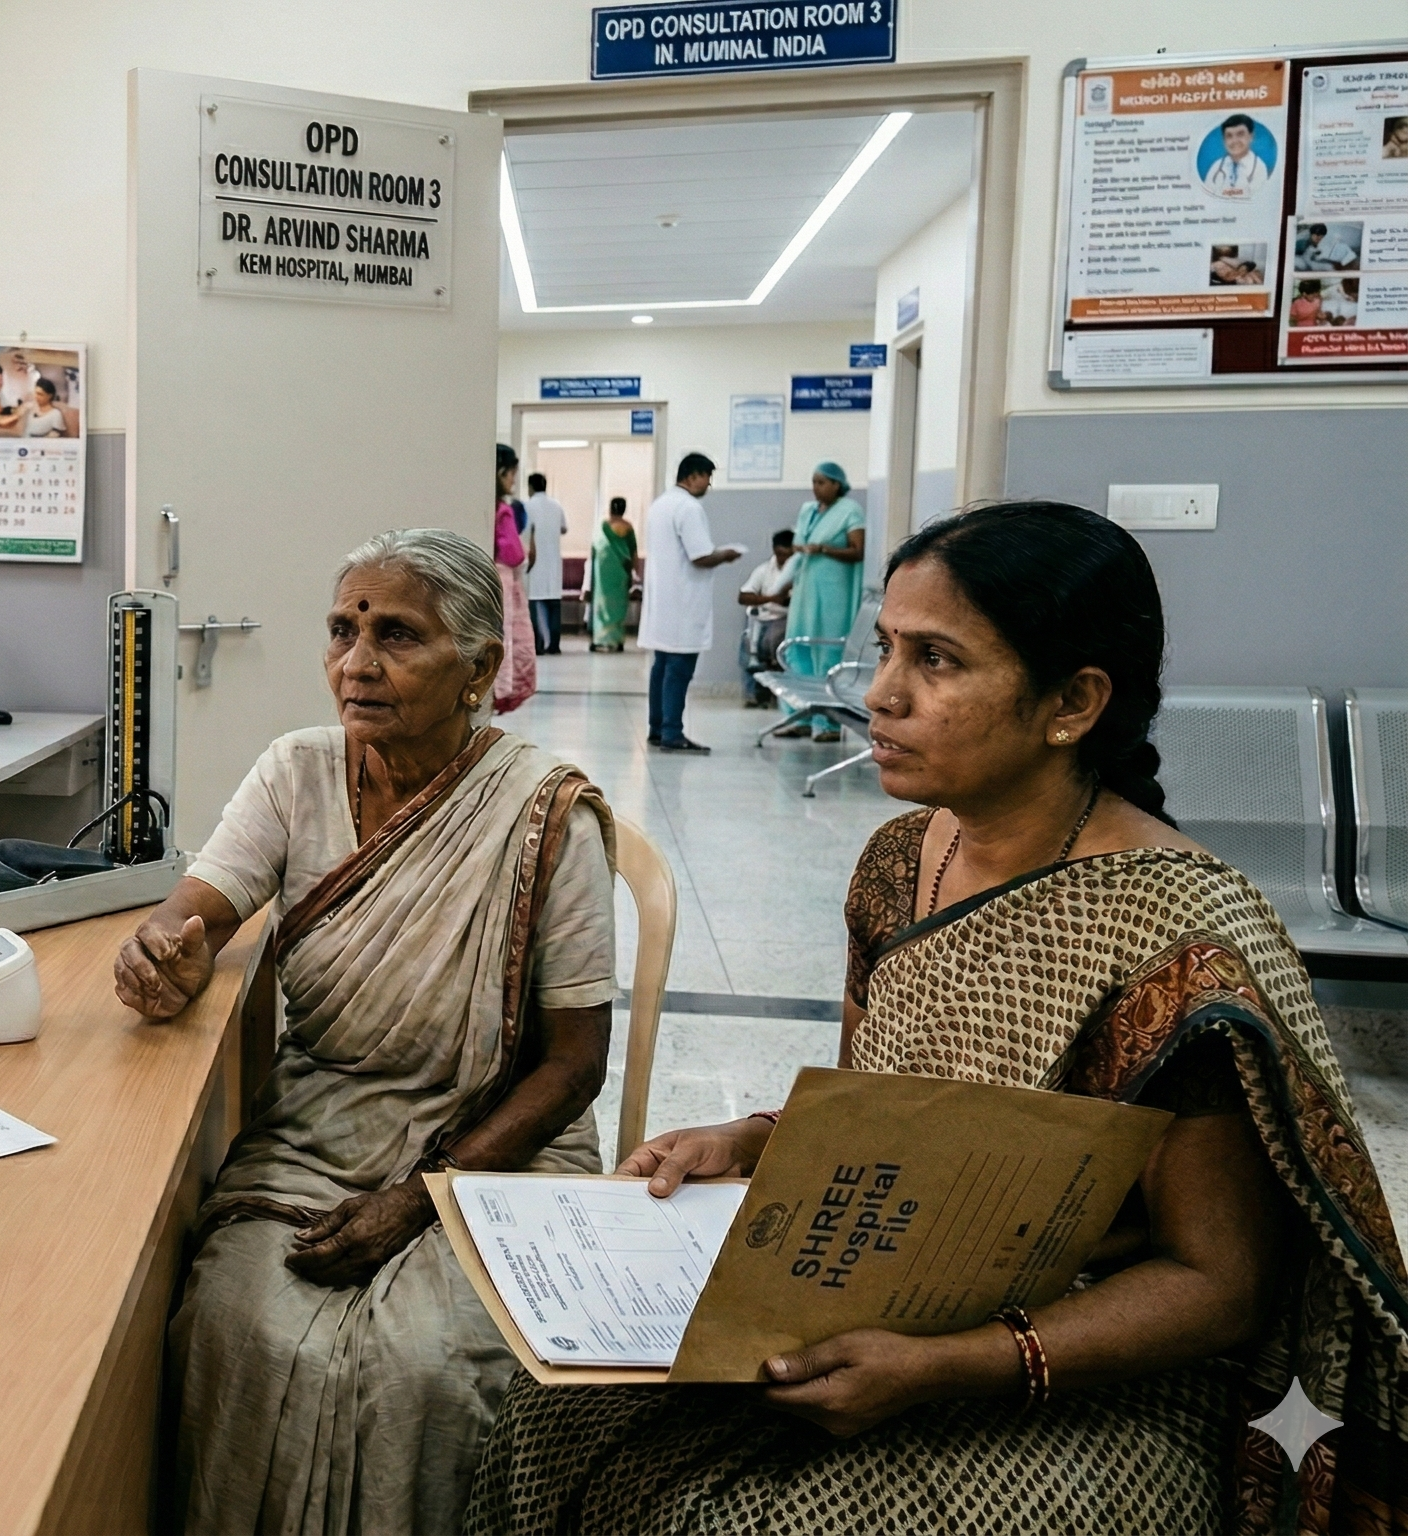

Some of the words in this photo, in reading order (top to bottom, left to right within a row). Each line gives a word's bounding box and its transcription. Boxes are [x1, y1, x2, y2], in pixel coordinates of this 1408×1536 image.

[605, 18, 645, 41] OPD
[651, 6, 798, 38] CONSULTATION
[803, 2, 864, 27] ROOM
[870, 2, 882, 23] 3
[773, 34, 827, 57] INDIA
[306, 121, 359, 156] OPD
[215, 153, 363, 200] CONSULTATION
[369, 171, 425, 207] ROOM
[429, 179, 441, 208] 3
[222, 211, 258, 243] DR.
[263, 215, 340, 250] ARVIND
[345, 223, 430, 260] SHARMA
[240, 252, 272, 276] KEM
[275, 256, 349, 286] HOSPITAL,
[354, 263, 413, 287] MUMBAI
[790, 1165, 866, 1279] SHREE
[820, 1163, 902, 1289] Hospital
[873, 1200, 919, 1252] File
